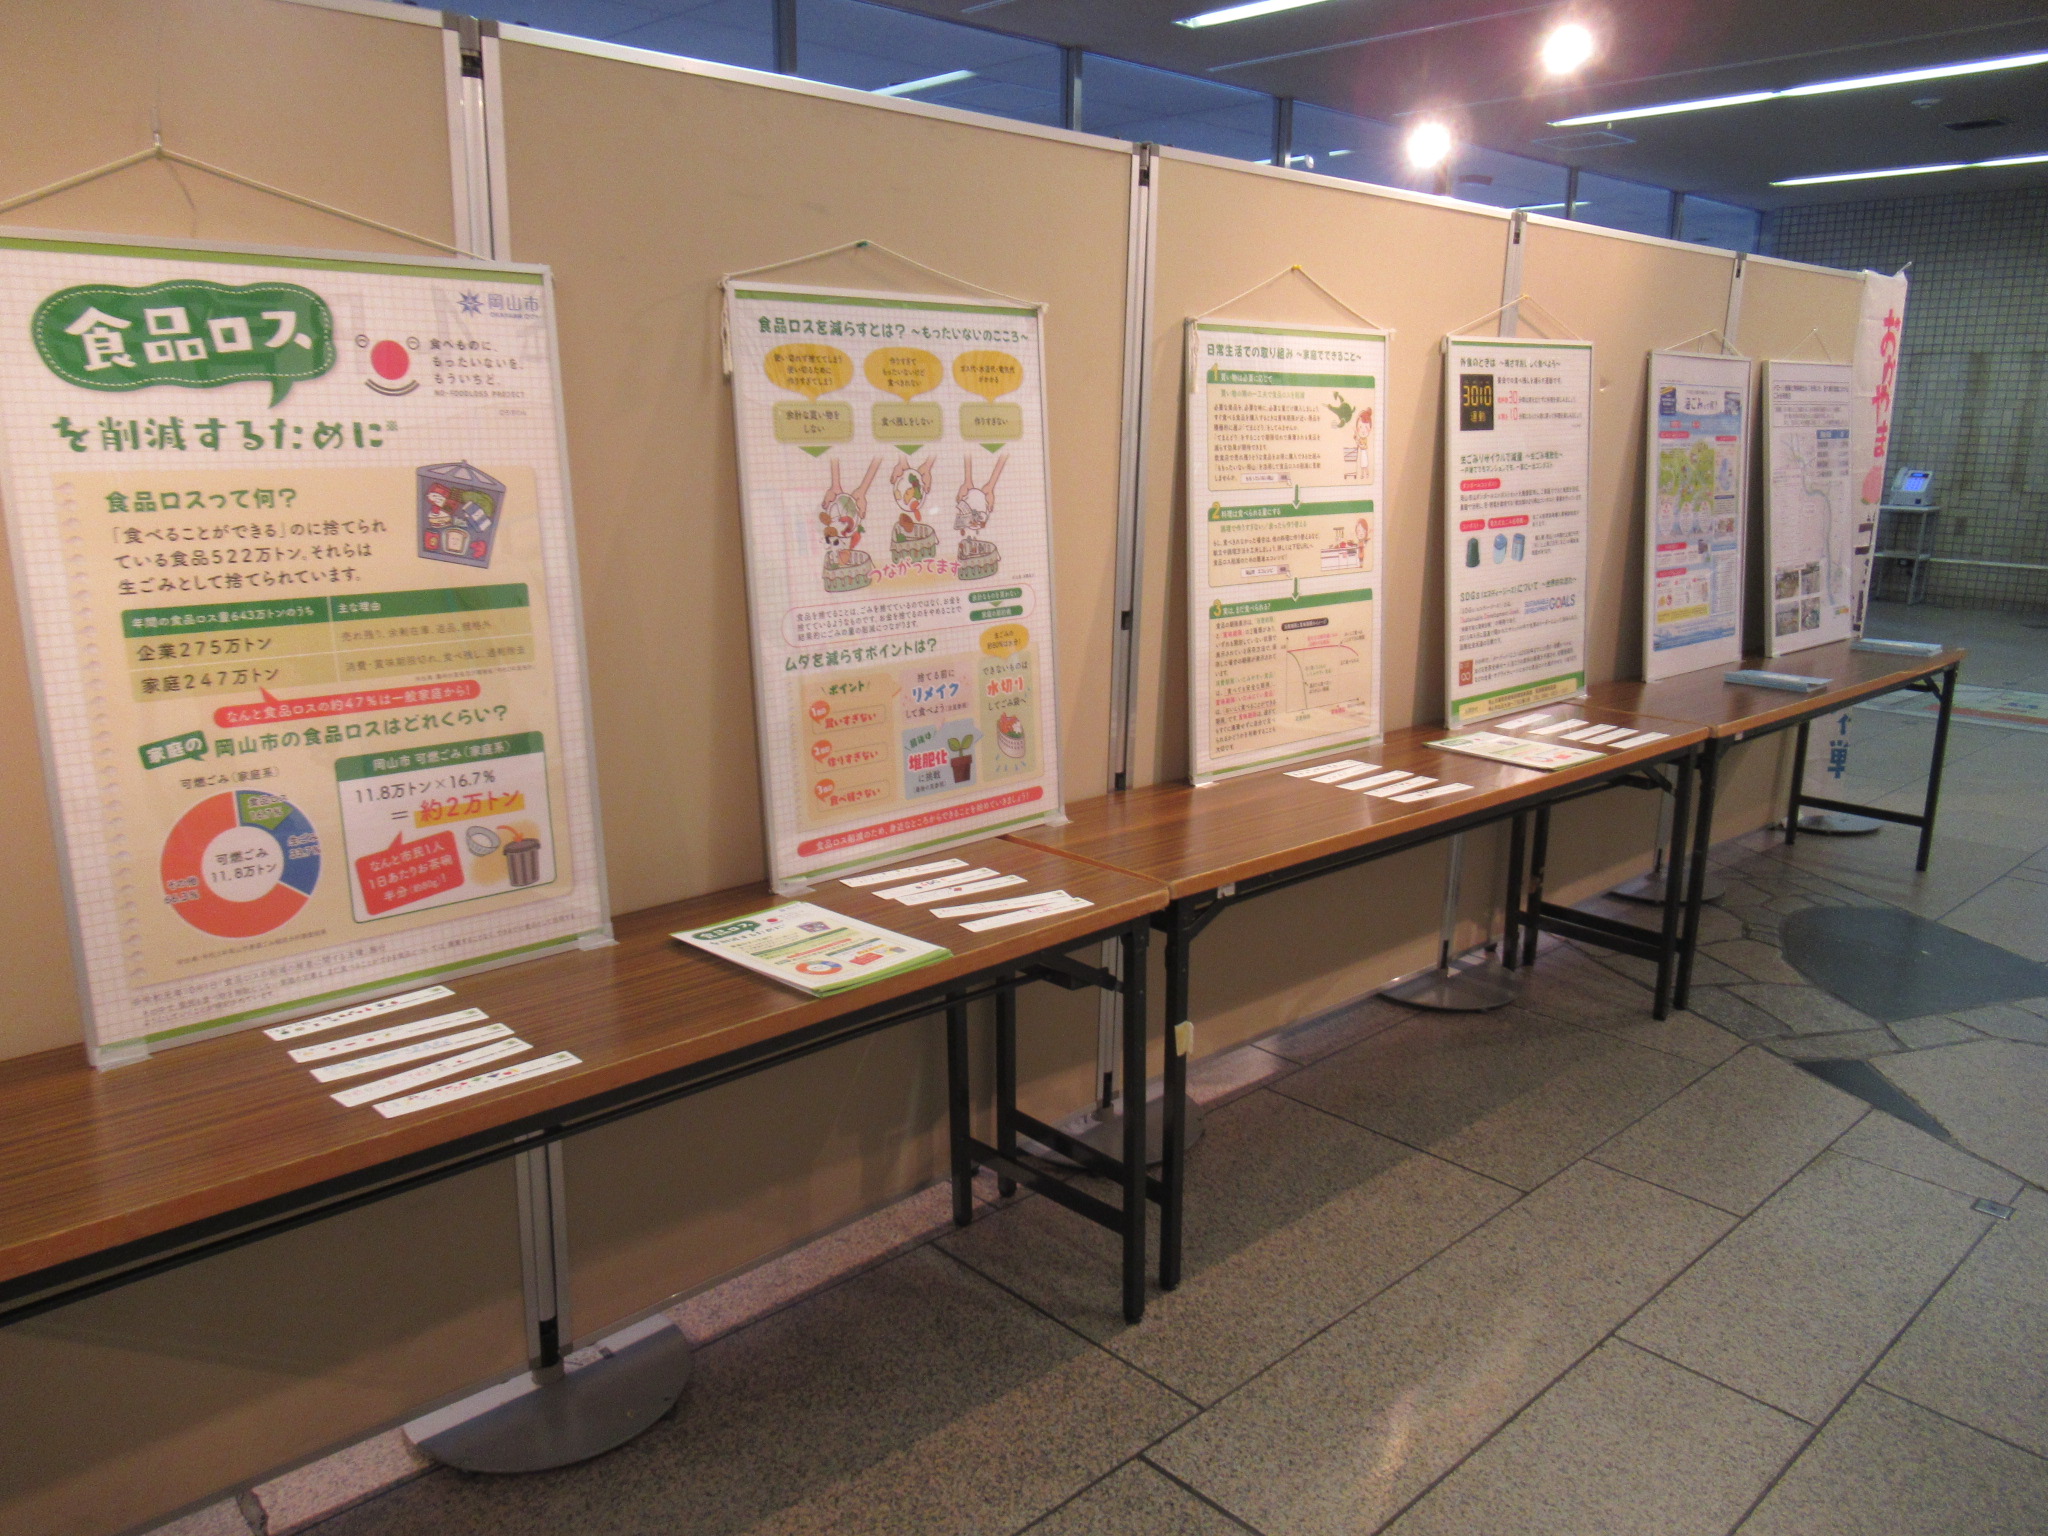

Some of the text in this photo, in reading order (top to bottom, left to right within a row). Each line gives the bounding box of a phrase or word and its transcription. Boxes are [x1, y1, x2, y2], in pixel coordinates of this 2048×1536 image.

[487, 293, 539, 311] 岡山市
[65, 306, 313, 372] 食品ロス
[759, 316, 906, 338] 食品ロスを減らすとは？
[1207, 343, 1294, 360] 日常生活での取り組み
[1463, 385, 1492, 407] 3010
[106, 487, 298, 515] 食品ロスって何？
[113, 518, 387, 546] 「食べることができる」のに捨てられ
[114, 541, 373, 570] ている食品522万トン。それらは
[118, 566, 362, 596] 生ごみとして捨てられています。
[867, 556, 962, 583] つながってます
[137, 637, 272, 662] 企業275万トン
[785, 638, 937, 671] ムダを減らすポイントは？
[917, 669, 955, 683] 捨てる前に
[983, 661, 1029, 676] できないものは
[141, 668, 279, 694] 家庭247万トン
[829, 680, 865, 695] ポイント
[912, 682, 960, 703] リメイク
[987, 677, 1024, 696] 水切り
[825, 713, 876, 729] 買いすぎない
[905, 705, 945, 718] して食べよう
[146, 705, 509, 764] 家庭の 岡山市の食品ロスはどれくらい？
[828, 751, 879, 767] 作りすぎない
[908, 748, 948, 771] 堆肥化
[355, 770, 496, 803] 11.8万トン×16.7%
[420, 790, 520, 822] 約2万トン
[369, 840, 445, 872] なんと市民1人
